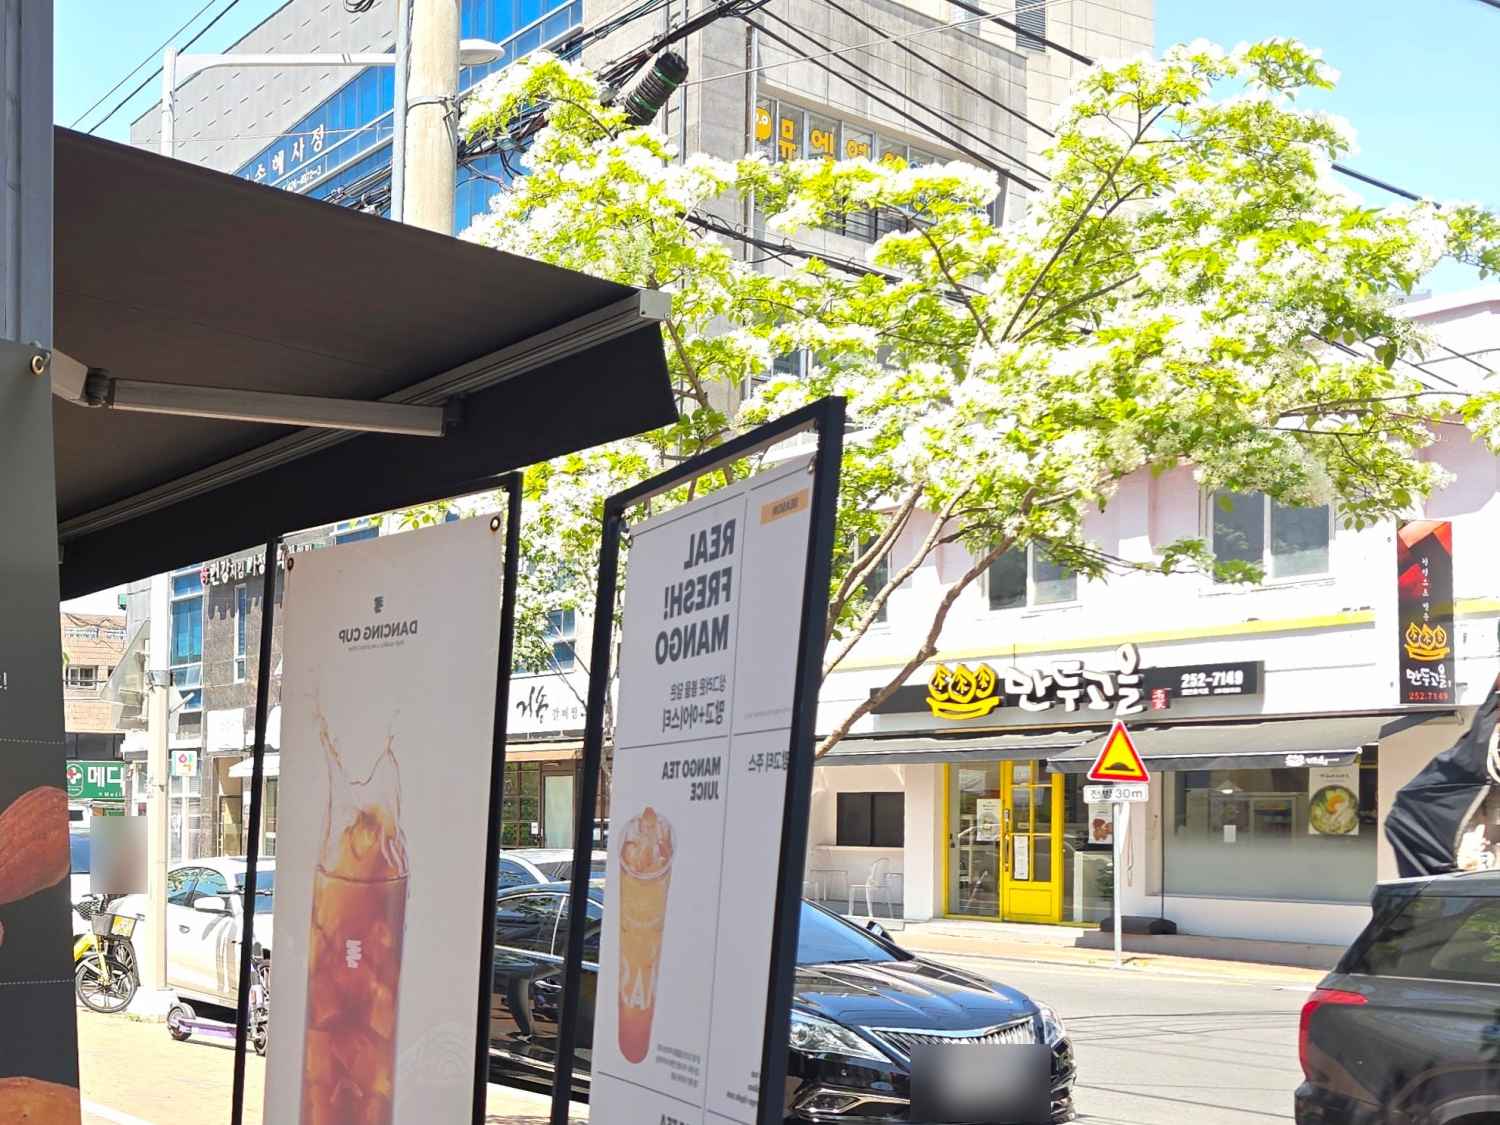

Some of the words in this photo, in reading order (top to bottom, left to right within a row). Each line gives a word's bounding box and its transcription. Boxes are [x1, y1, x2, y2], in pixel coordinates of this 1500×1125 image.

[1004, 642, 1144, 716] 만두고을
[1181, 670, 1244, 689] 252-7149
[1406, 664, 1447, 688] 만두고을
[1091, 788, 1113, 799] 전방
[1115, 788, 1143, 799] 30m
